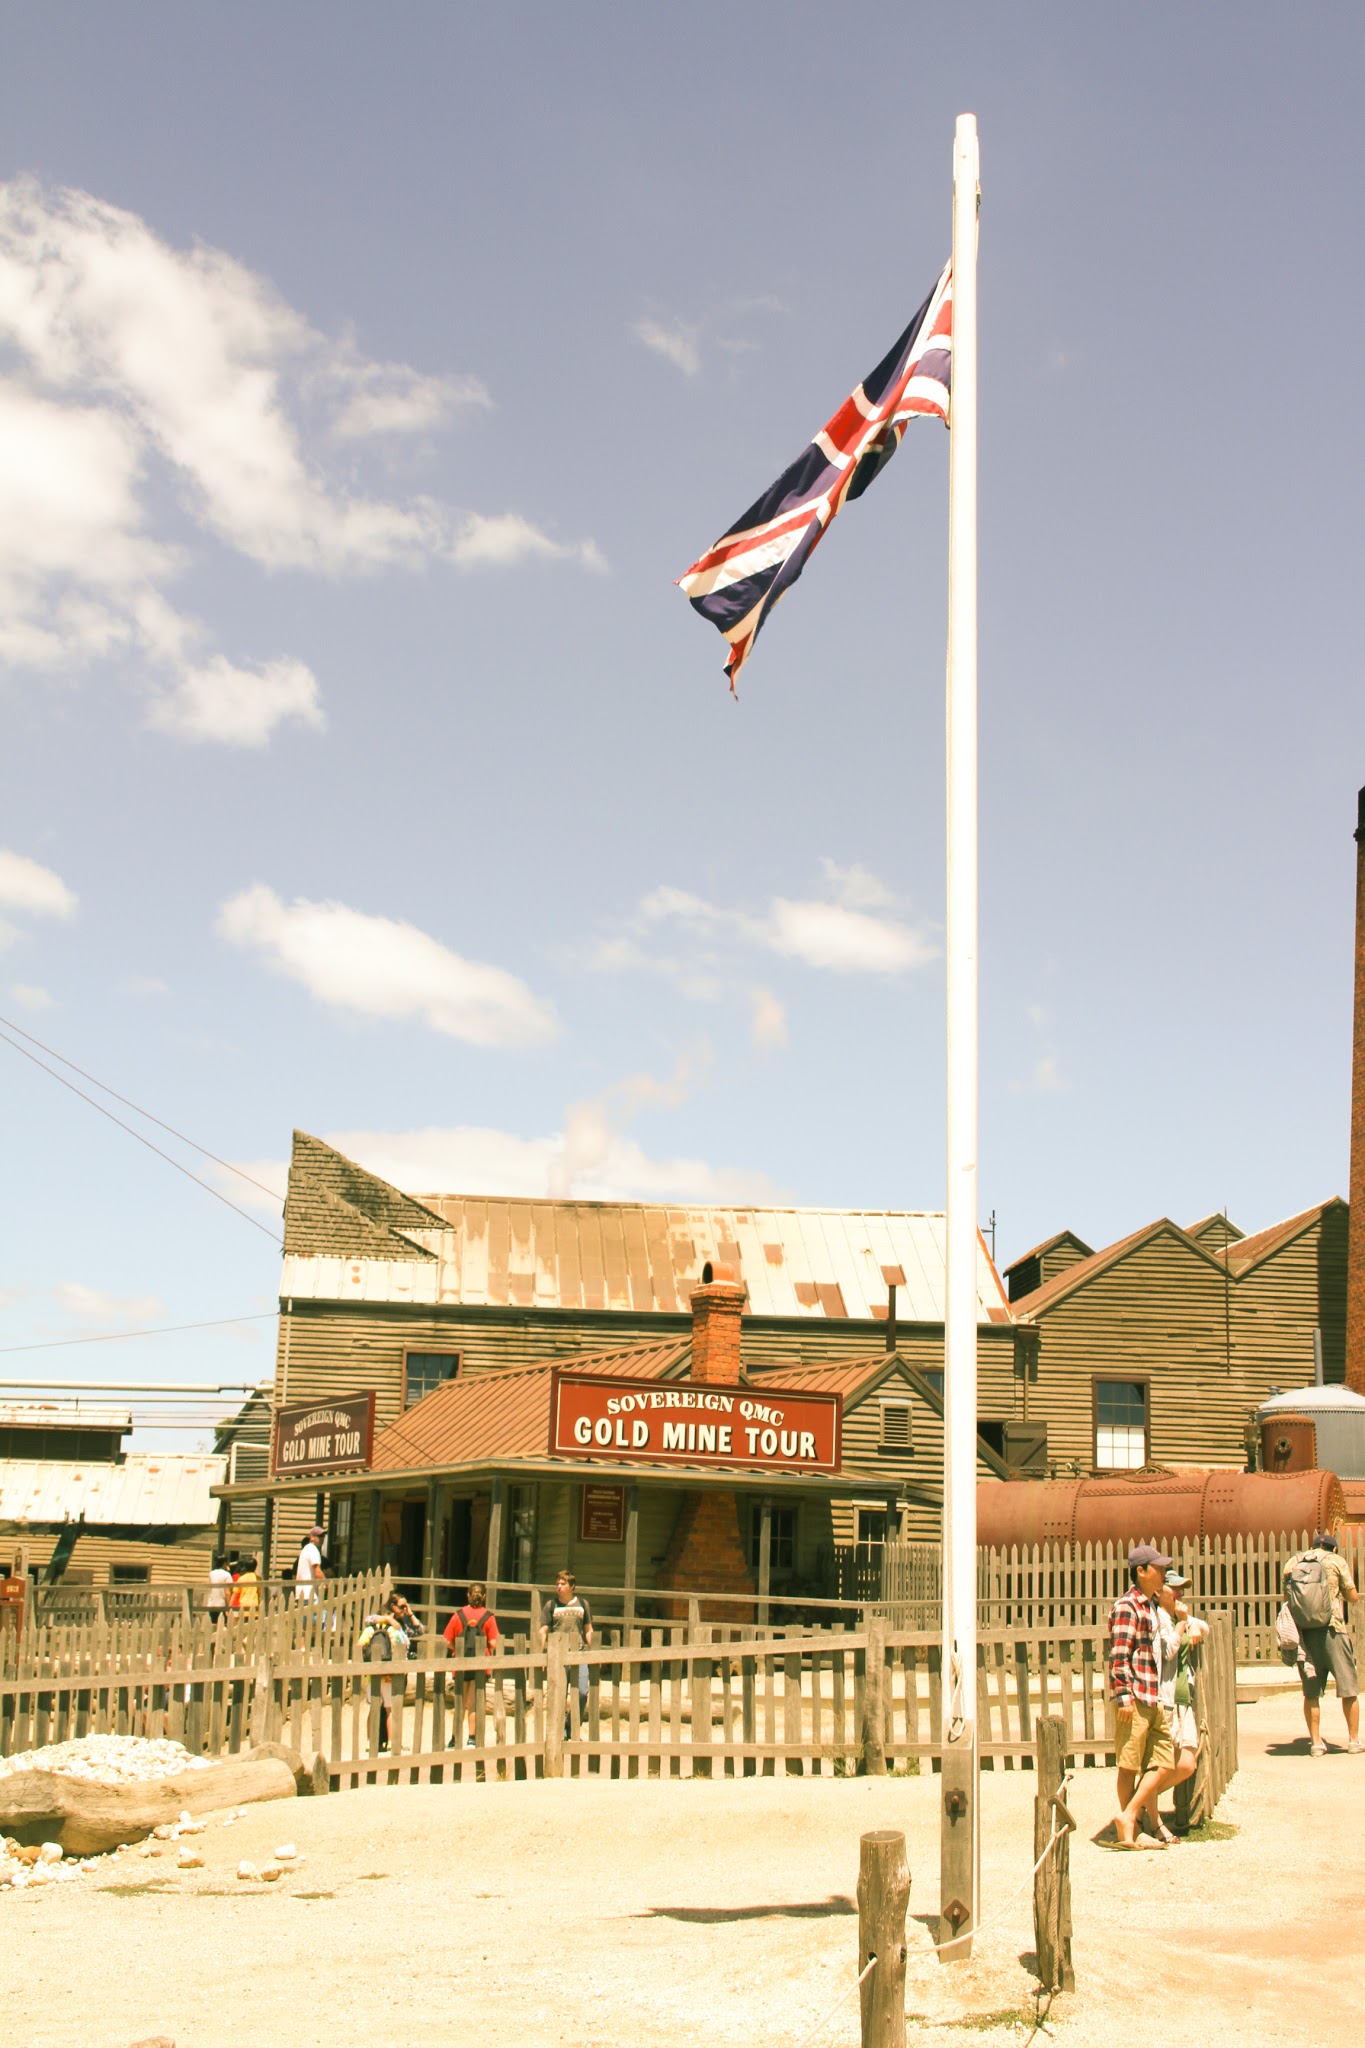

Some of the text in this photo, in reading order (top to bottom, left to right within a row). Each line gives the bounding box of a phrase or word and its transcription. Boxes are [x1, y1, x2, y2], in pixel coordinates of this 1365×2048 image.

[294, 1410, 351, 1436] SOVEREIGN QMC
[606, 1391, 784, 1426] SOVEREIGN QMC
[282, 1431, 360, 1463] GOLD MINE TOUR
[574, 1417, 816, 1459] GOLD MINE TOUR
